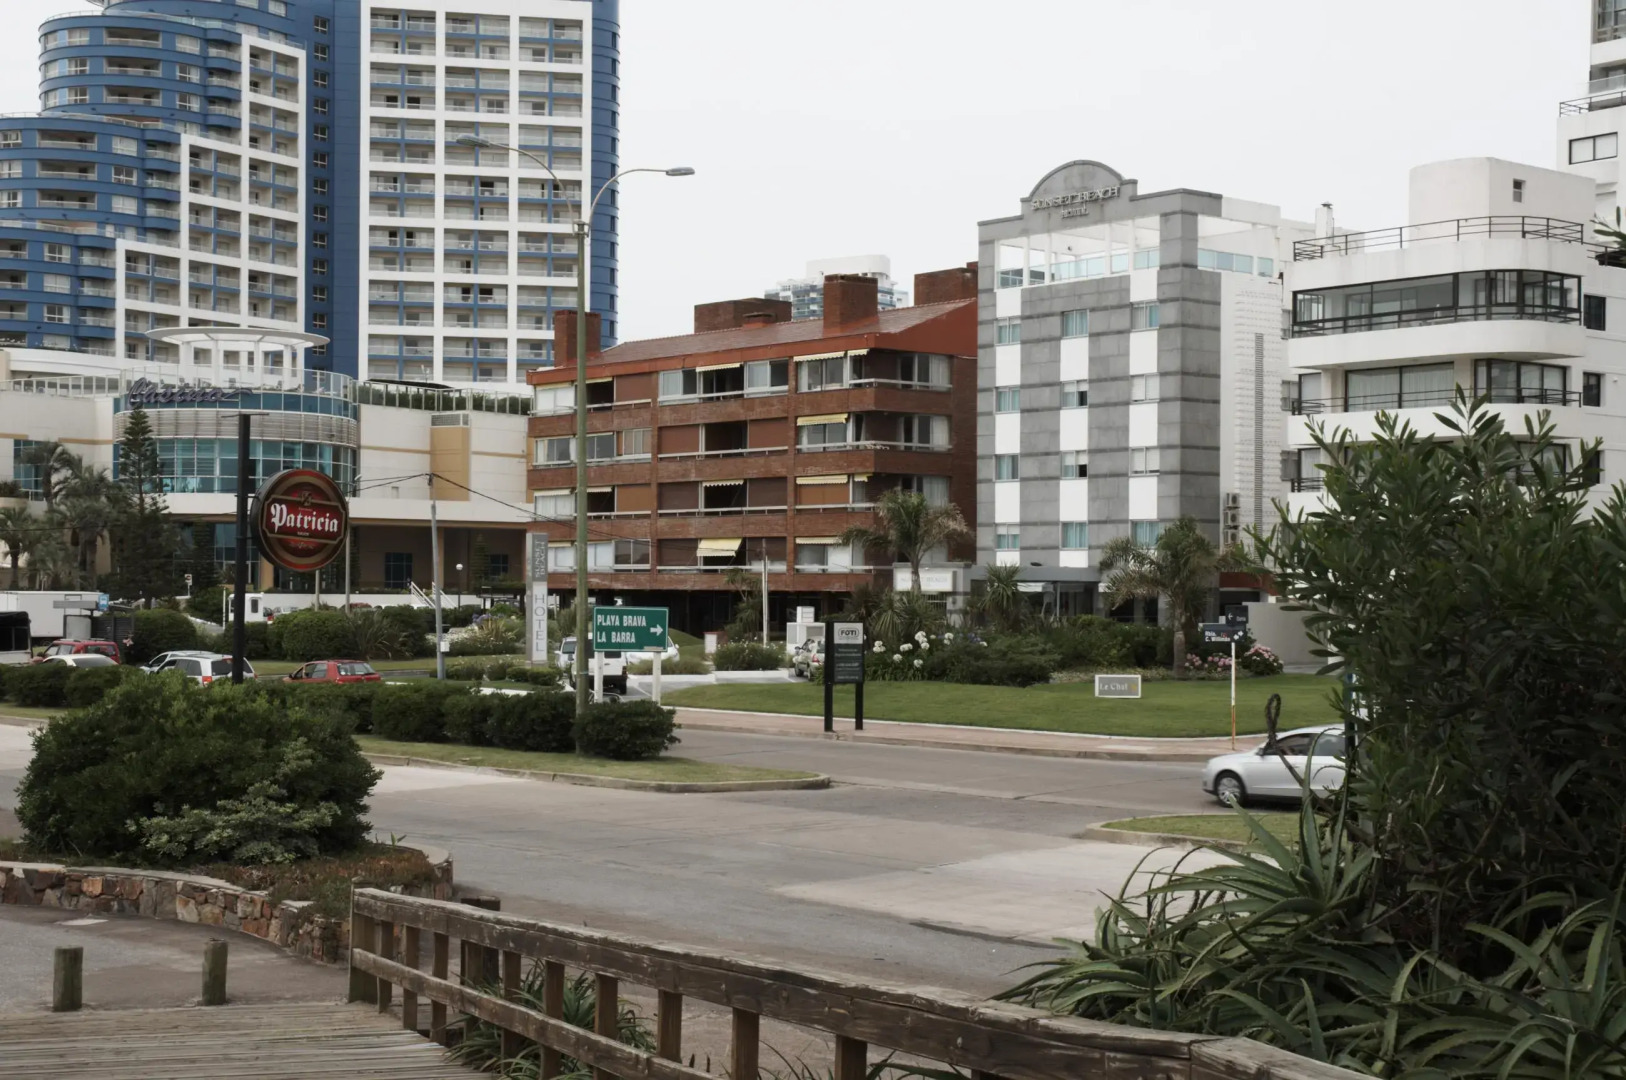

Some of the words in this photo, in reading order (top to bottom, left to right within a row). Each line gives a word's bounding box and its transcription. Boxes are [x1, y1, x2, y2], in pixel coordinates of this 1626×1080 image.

[1032, 192, 1080, 210] SUNSET
[1080, 186, 1120, 203] BEACH
[128, 377, 253, 410] Casino
[270, 503, 338, 533] Patricia
[535, 594, 545, 652] HOTEL
[597, 614, 620, 626] PLAYA
[623, 615, 647, 627] BRAVA
[597, 631, 607, 643] LA
[611, 631, 636, 643] BARRA
